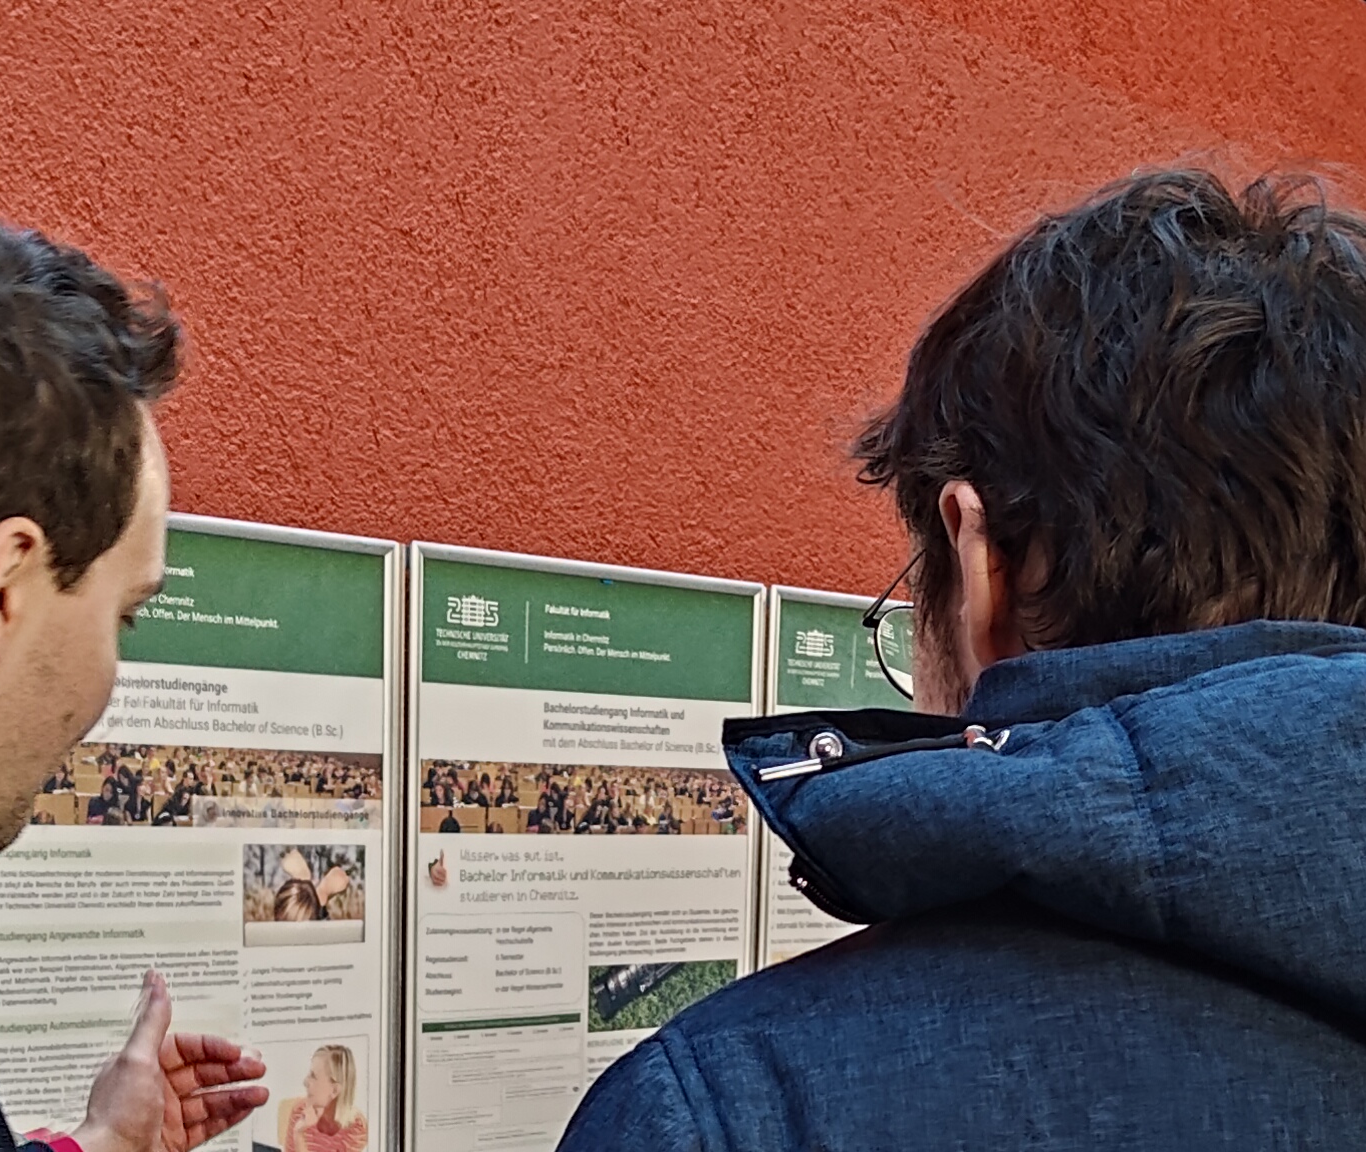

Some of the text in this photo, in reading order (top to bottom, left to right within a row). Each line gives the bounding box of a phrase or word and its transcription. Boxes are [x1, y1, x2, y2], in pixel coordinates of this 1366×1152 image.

[177, 610, 191, 621] Der
[192, 612, 222, 624] Mensch
[190, 699, 204, 711] für
[207, 701, 259, 714] Informatik
[544, 702, 685, 720] Bachelorstudiengang Informatik und
[154, 717, 209, 731] Abschluss
[212, 720, 256, 732] Bachelor
[259, 721, 268, 733] of
[270, 723, 308, 736] Science
[543, 720, 670, 735] Kommunikationswissenschaften
[460, 870, 508, 882] Bachelor
[511, 868, 566, 882] Informatik
[569, 869, 588, 881] und
